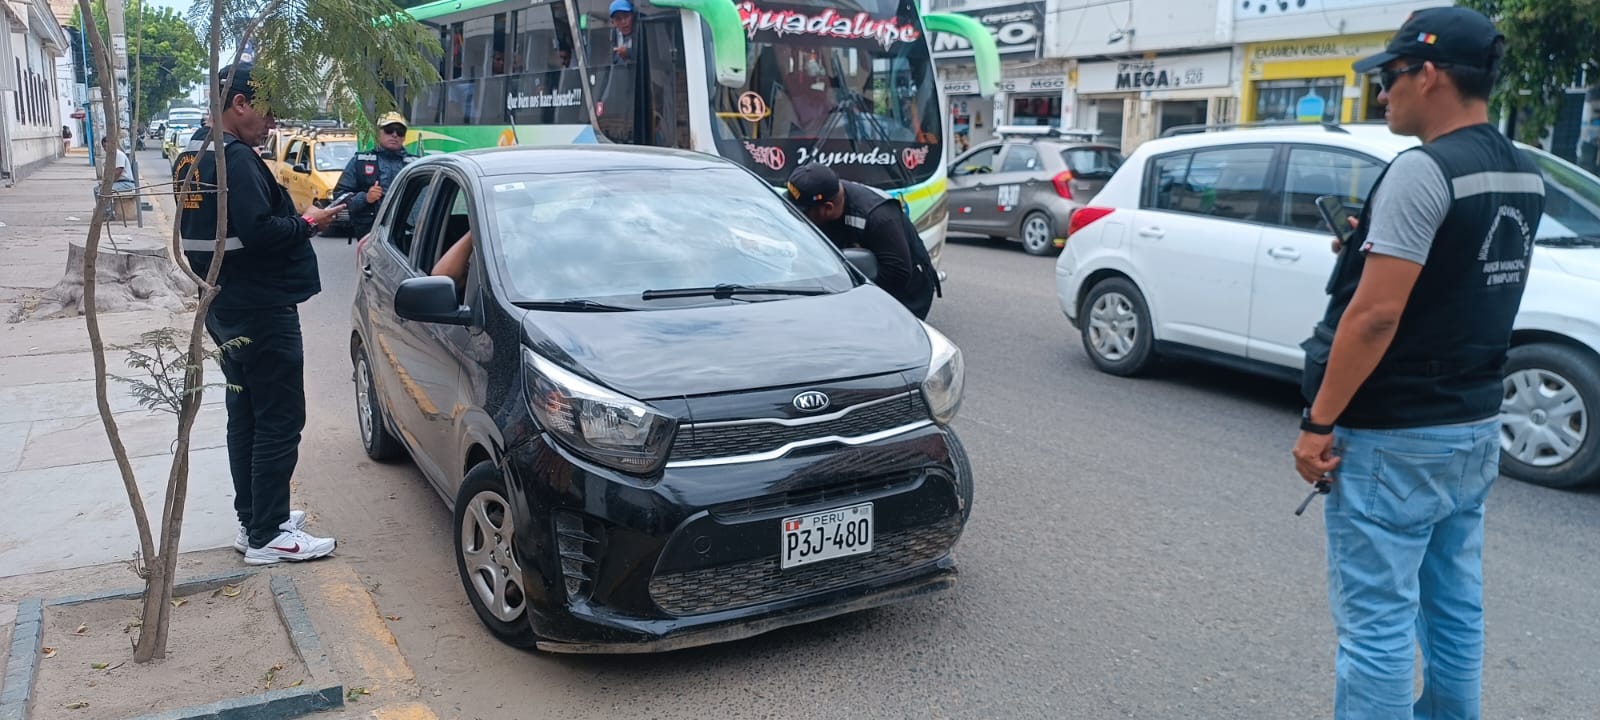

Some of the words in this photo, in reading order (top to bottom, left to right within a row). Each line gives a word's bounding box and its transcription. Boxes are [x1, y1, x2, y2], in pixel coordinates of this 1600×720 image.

[1116, 70, 1169, 90] MEGA
[742, 96, 762, 115] 31
[797, 147, 897, 168] Hyundai
[799, 394, 825, 409] KIA
[813, 512, 845, 526] PERU
[787, 518, 869, 561] P3J-480
